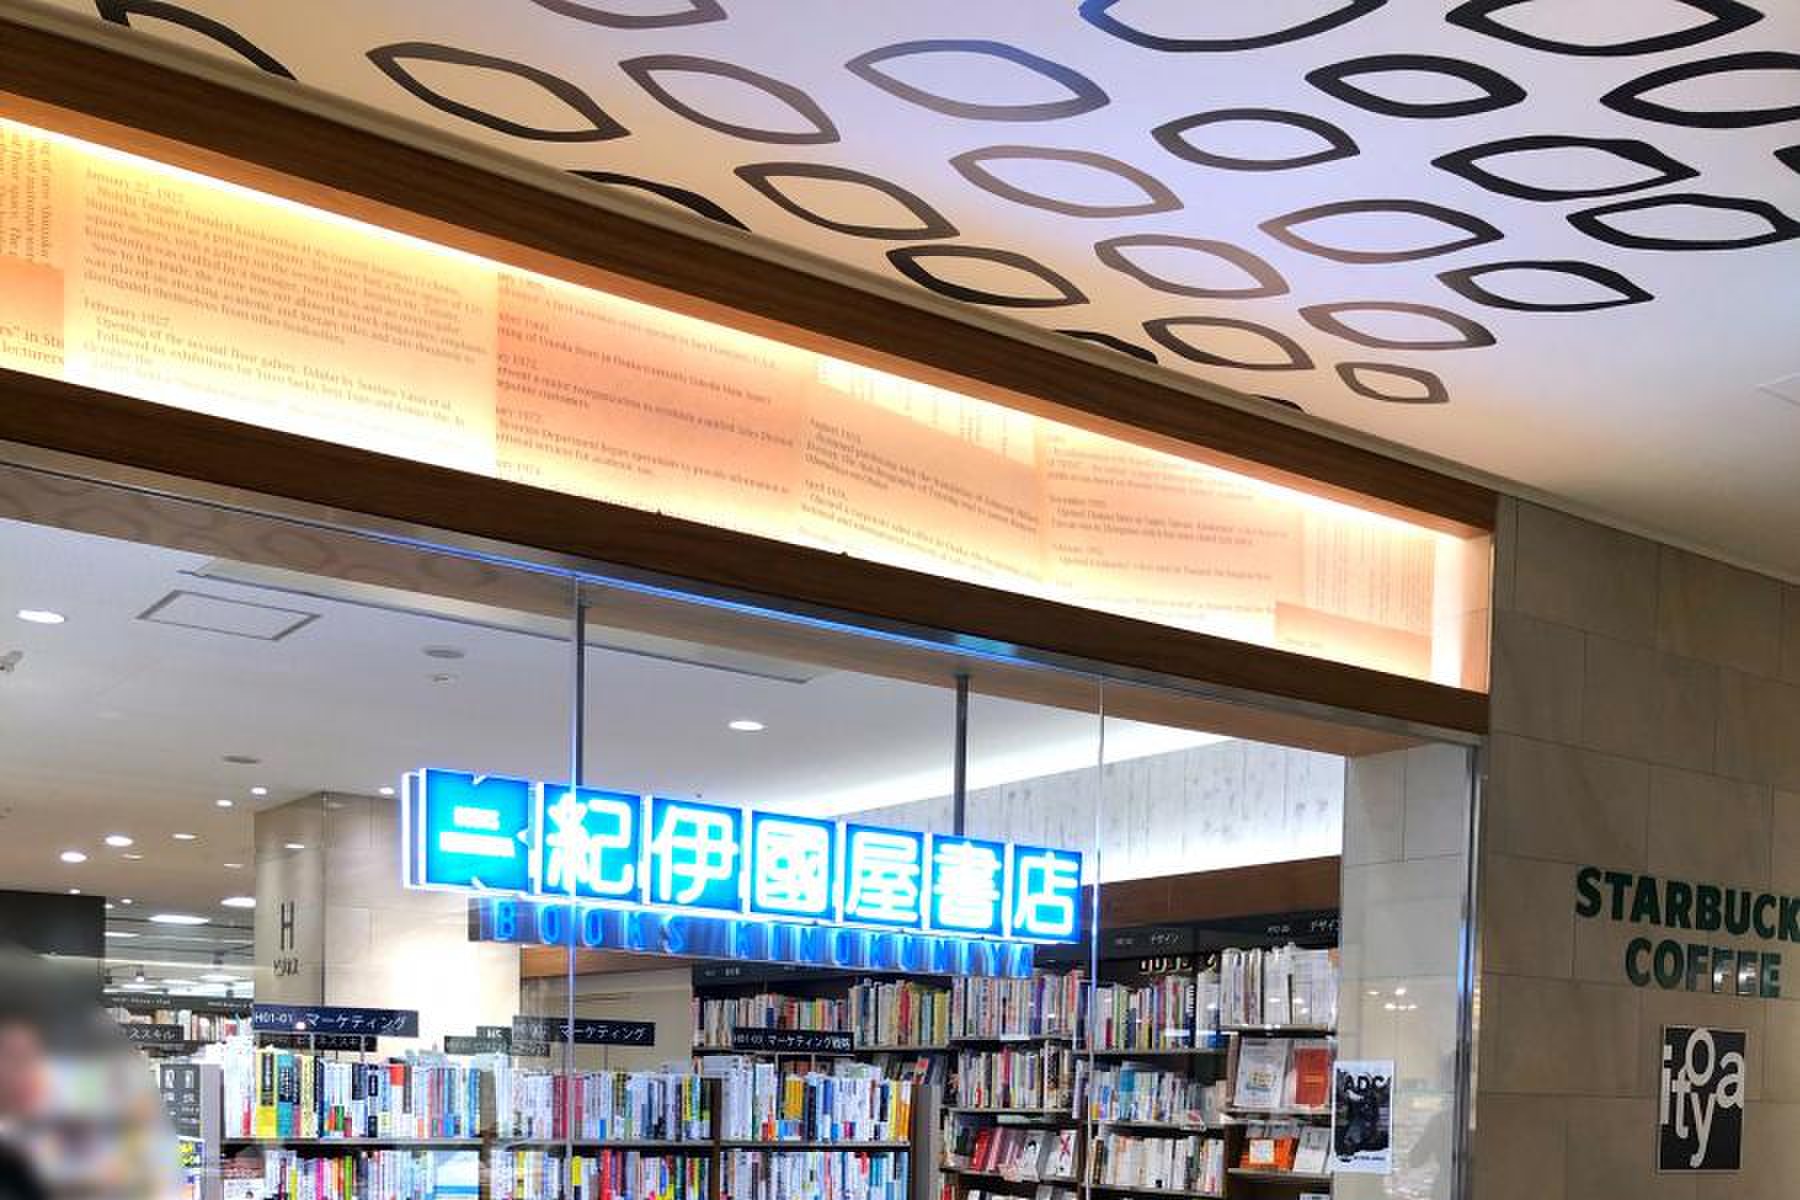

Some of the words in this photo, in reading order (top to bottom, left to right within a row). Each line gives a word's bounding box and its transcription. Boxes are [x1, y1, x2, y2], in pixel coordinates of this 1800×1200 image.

[546, 792, 1077, 934] 紀伊國屋書店
[281, 901, 295, 951] H
[494, 898, 684, 955] BOOKS
[1625, 937, 1782, 998] COFFEE
[305, 1012, 407, 1032] マーケティング
[559, 1023, 646, 1041] マーケティング
